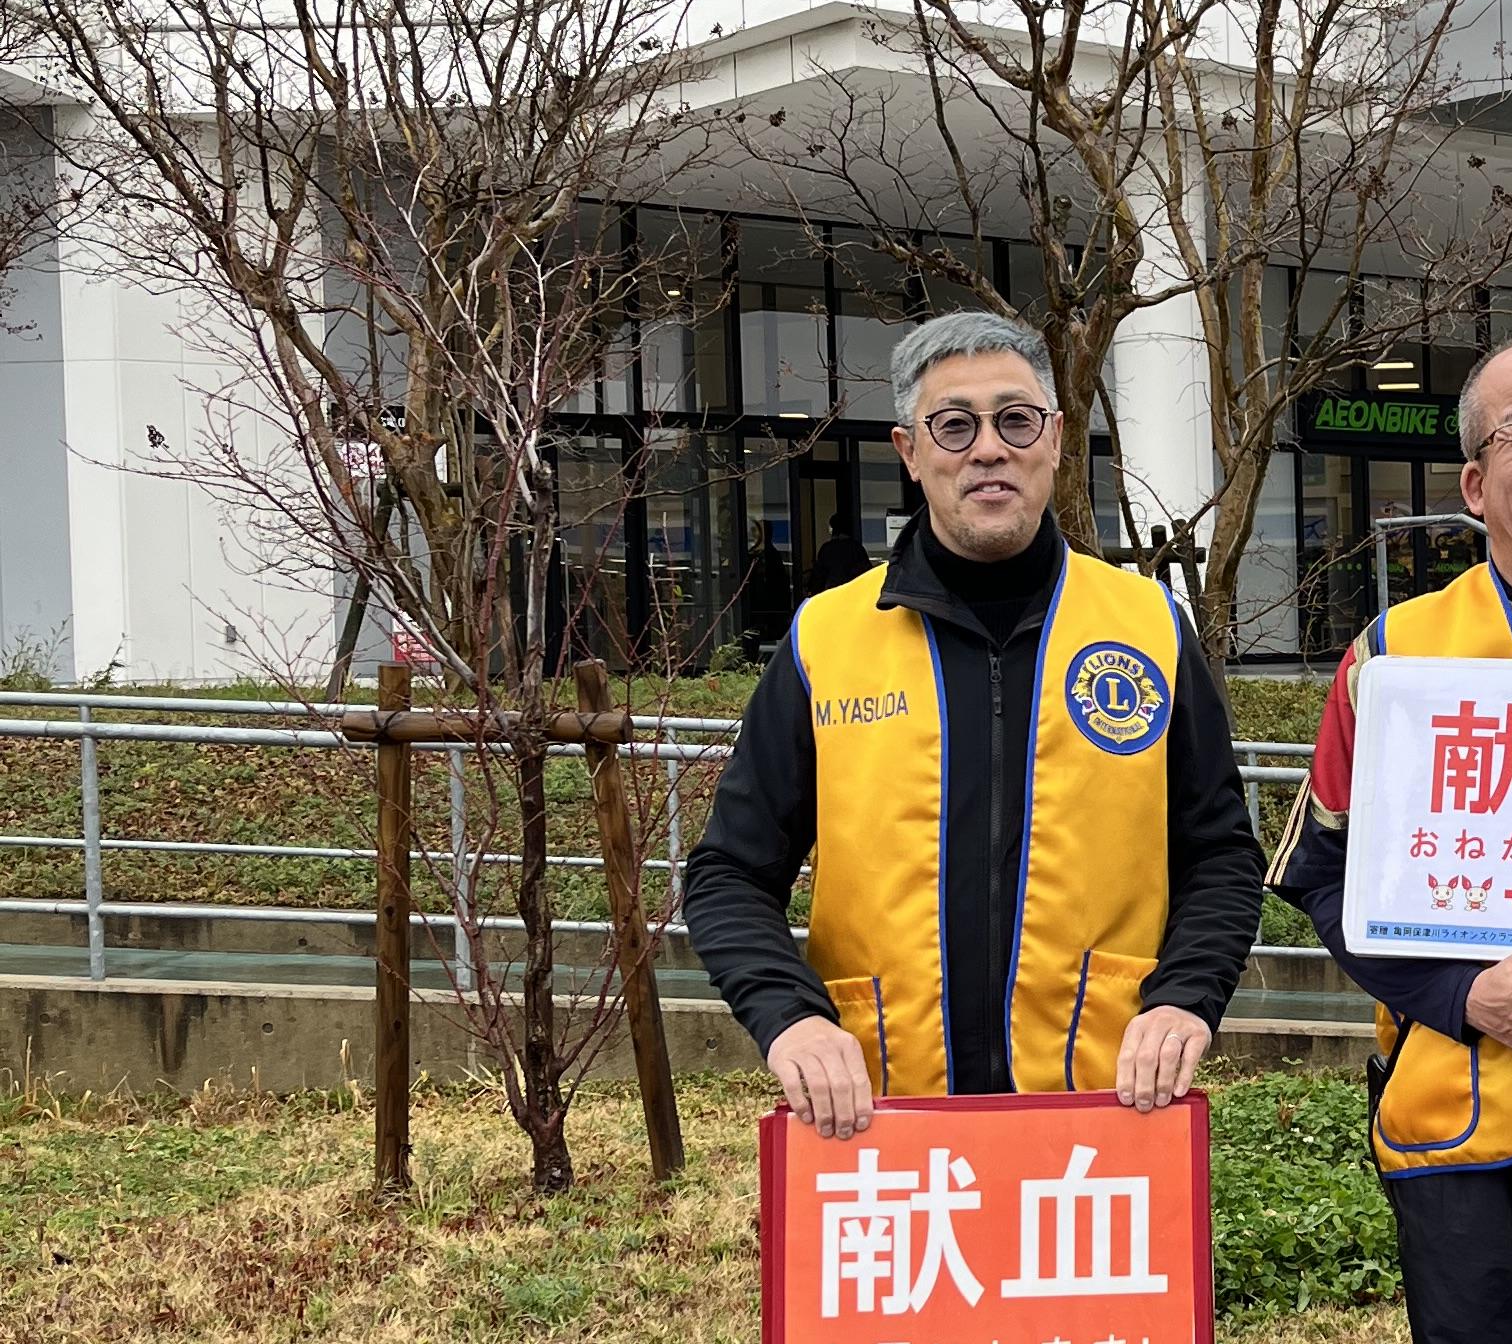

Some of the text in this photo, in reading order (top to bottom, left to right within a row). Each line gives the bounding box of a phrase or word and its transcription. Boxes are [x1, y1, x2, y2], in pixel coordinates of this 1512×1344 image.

[1088, 652, 1141, 675] LIONS
[815, 690, 909, 728] M.YASUDA
[1105, 677, 1130, 711] L
[815, 1144, 1169, 1318] 献血
